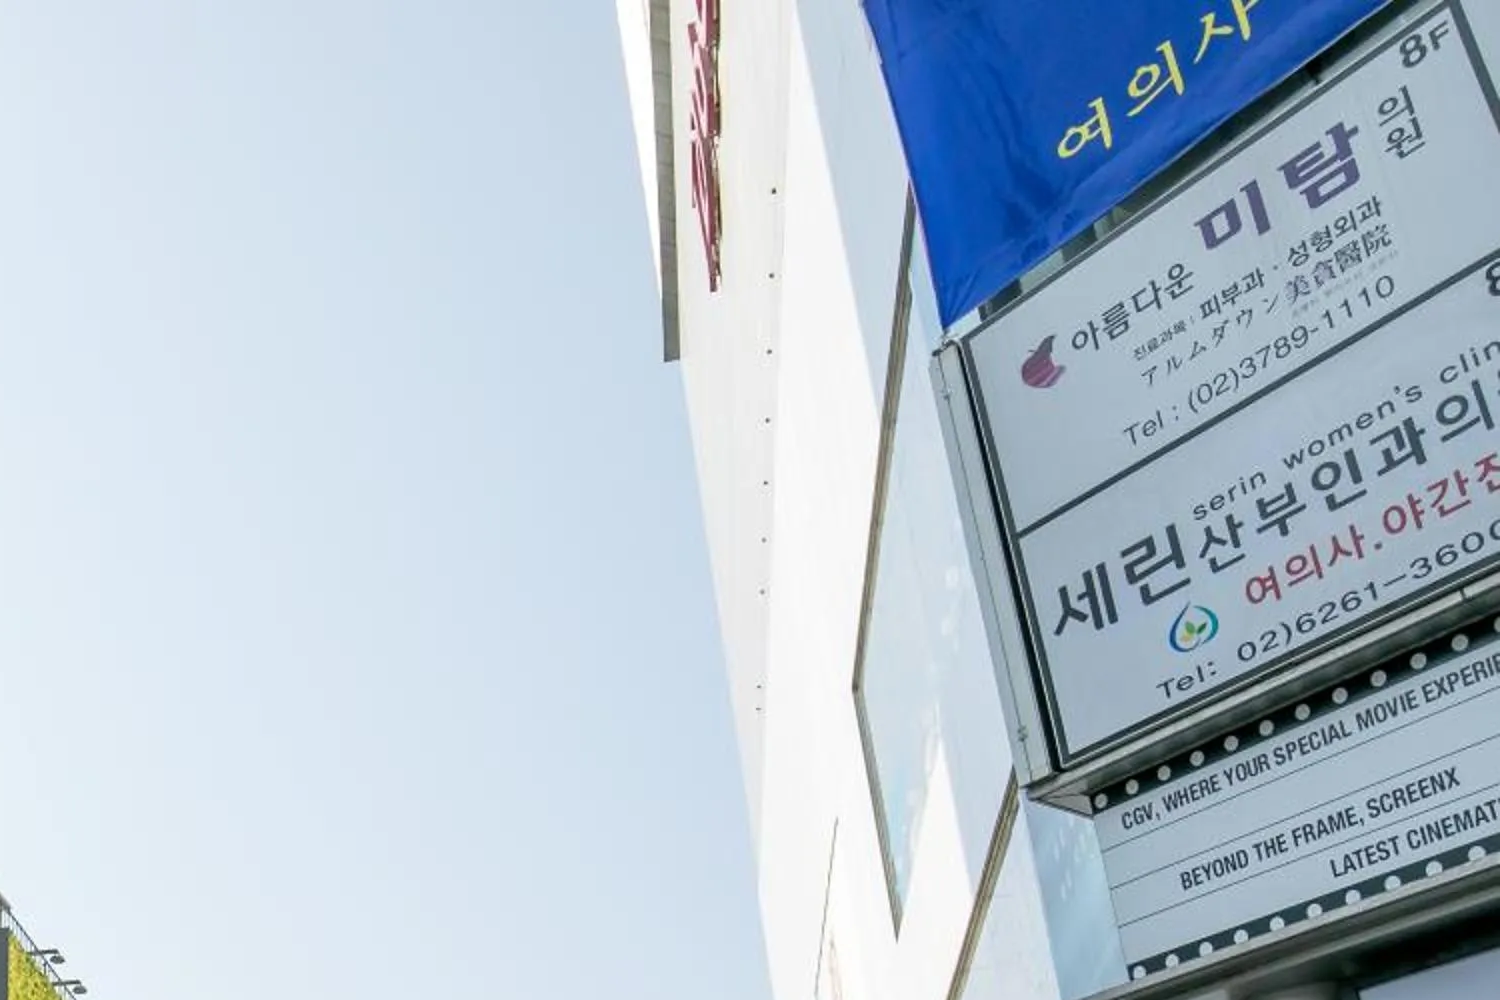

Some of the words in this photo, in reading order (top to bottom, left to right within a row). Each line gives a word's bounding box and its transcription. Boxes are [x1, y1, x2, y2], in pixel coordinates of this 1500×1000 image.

[1399, 19, 1450, 68] 8F
[1071, 263, 1194, 352] 아름다운
[1194, 121, 1360, 250] 미탐
[1199, 268, 1265, 320] 피부과
[1287, 195, 1384, 268] 성형외과
[1188, 274, 1395, 414] (02)3789-1110
[1053, 369, 1500, 637] 세린산부인과의
[1192, 470, 1267, 520] serin
[1283, 384, 1423, 470] women's
[1121, 800, 1161, 831] CGV,
[1161, 780, 1221, 821] WHERE
[1222, 753, 1272, 787] YOUR
[1273, 720, 1352, 767] SPECIAL
[1354, 689, 1420, 730] MOVIE
[1179, 849, 1250, 892] BEYOND
[1252, 833, 1290, 862] THE
[1291, 805, 1366, 849] FRAME,
[1367, 766, 1461, 821] SCREENX
[1328, 840, 1400, 879] LATEST
[1406, 797, 1500, 851] CINEMAT
